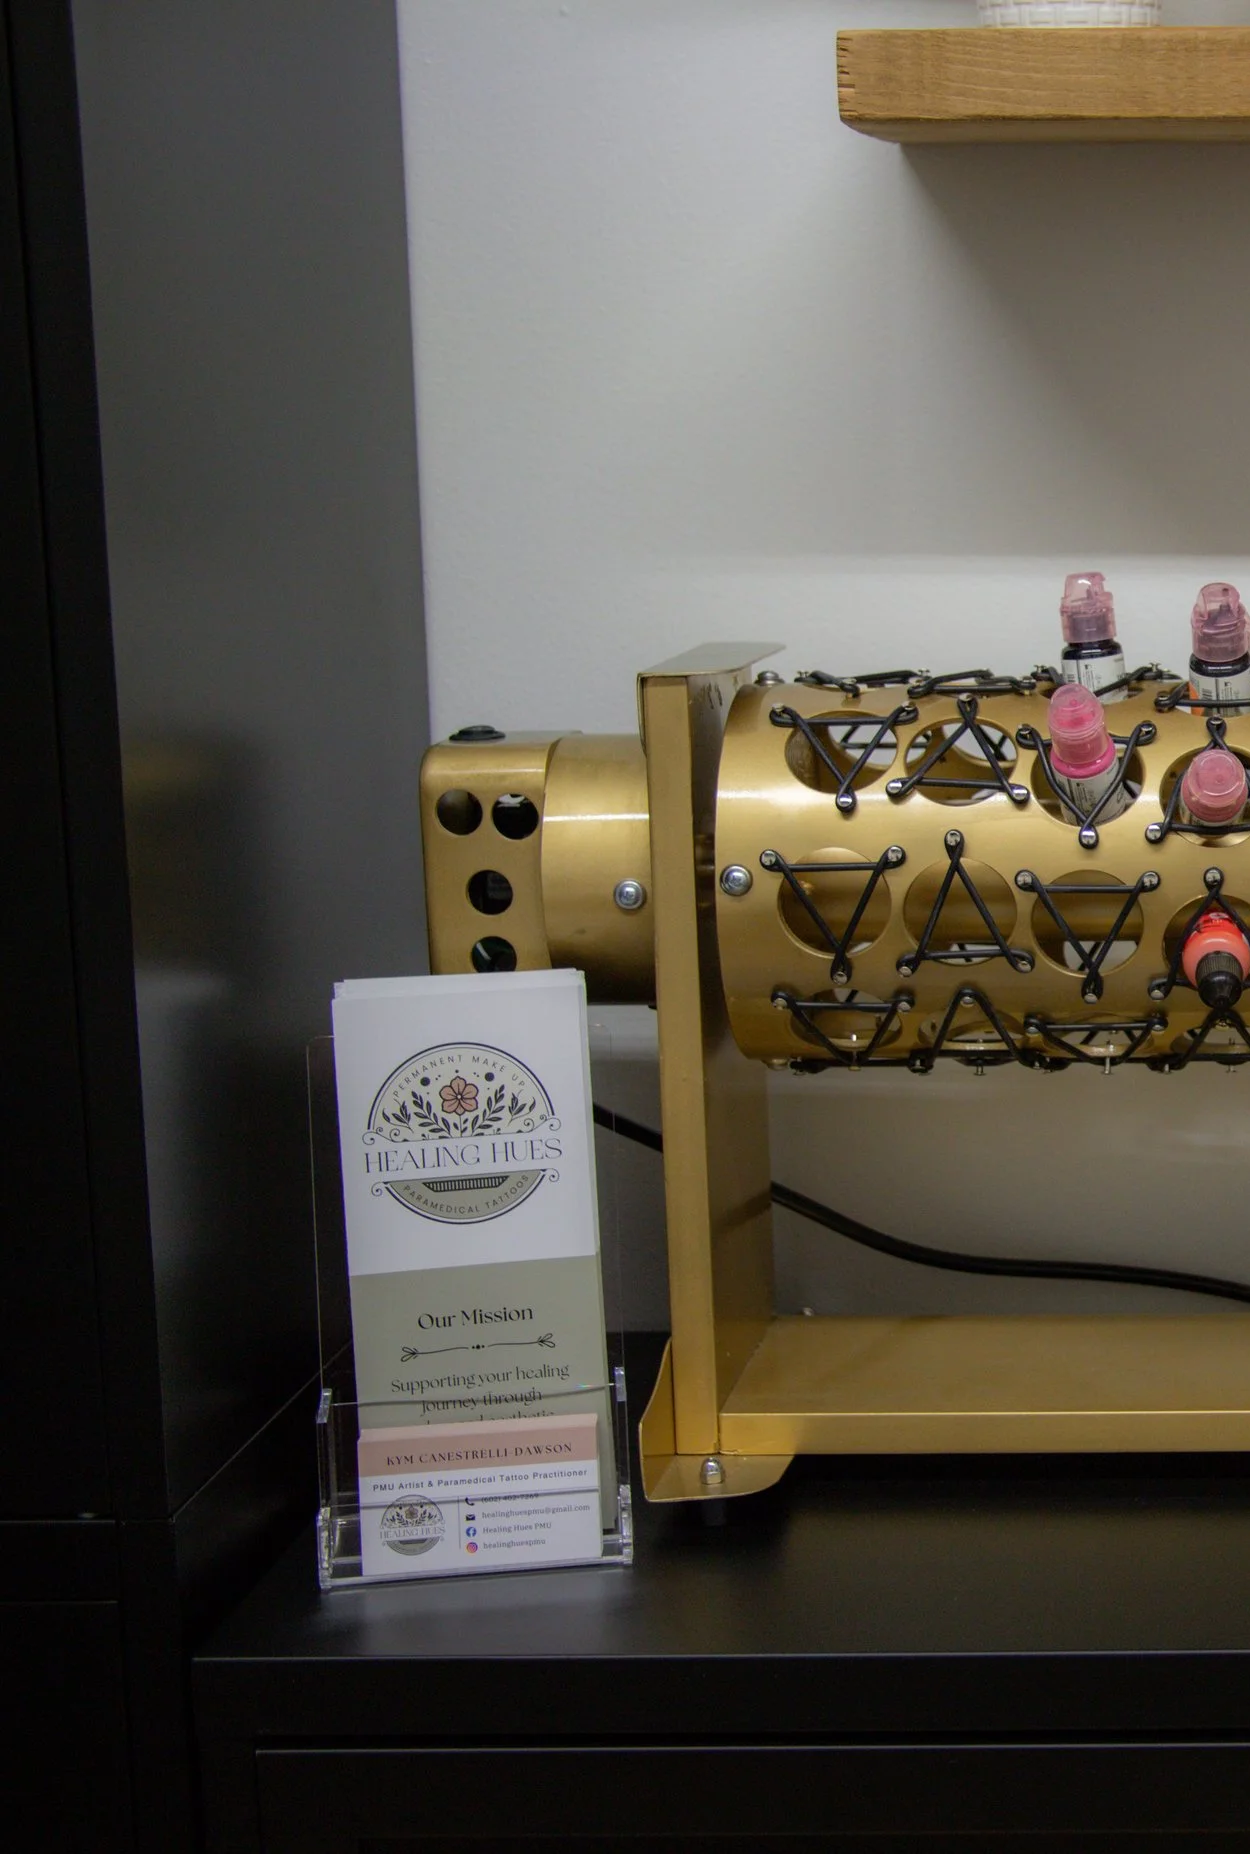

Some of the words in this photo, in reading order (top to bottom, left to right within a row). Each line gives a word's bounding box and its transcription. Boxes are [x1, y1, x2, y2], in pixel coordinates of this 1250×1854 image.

[392, 1054, 463, 1099] PERMANENT
[471, 1055, 507, 1073] MAKE
[511, 1074, 526, 1088] UP
[364, 1144, 481, 1174] HEALING
[491, 1138, 563, 1165] HUES
[403, 1184, 480, 1215] PARAMEDICAL
[485, 1174, 530, 1210] TATTOOS
[417, 1312, 457, 1330] Our
[460, 1306, 534, 1327] Mission
[391, 1374, 476, 1395] Supporting
[476, 1369, 512, 1391] your
[516, 1364, 570, 1385] healing
[386, 1454, 414, 1467] KYM
[372, 1483, 395, 1492] PMU
[397, 1480, 424, 1490] Artist
[427, 1479, 434, 1488] &
[437, 1475, 496, 1488] Paramedical
[499, 1472, 529, 1482] Tattoo
[532, 1468, 588, 1480] Practitioner
[482, 1526, 512, 1535] Healing
[513, 1524, 533, 1532] Hues
[534, 1522, 552, 1530] PMU
